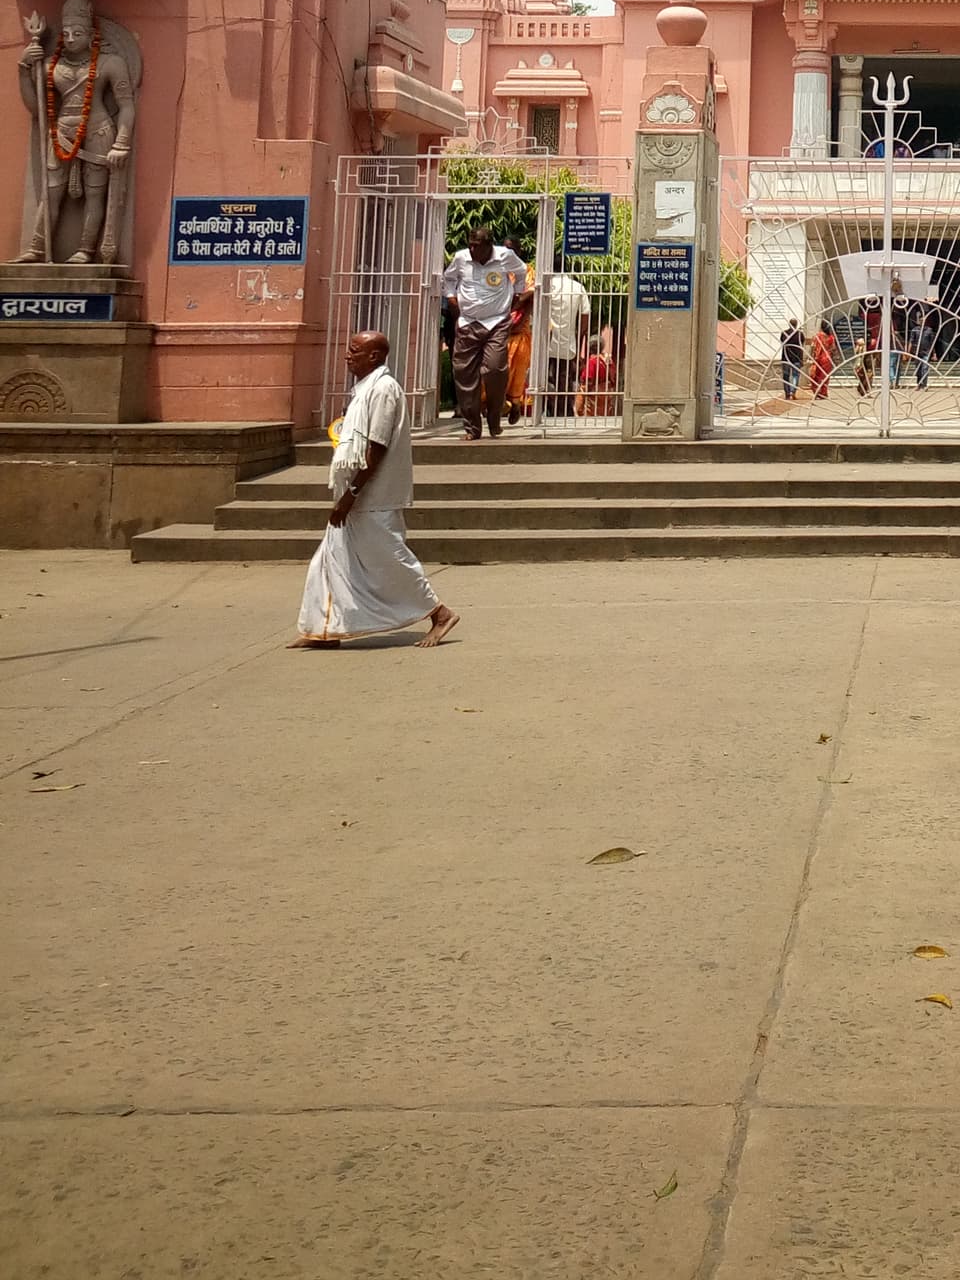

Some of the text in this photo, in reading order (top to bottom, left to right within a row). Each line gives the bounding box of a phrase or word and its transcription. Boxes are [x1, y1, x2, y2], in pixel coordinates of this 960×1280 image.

[664, 186, 686, 195] अन्दर
[220, 204, 257, 214] सूचना
[179, 216, 233, 235] दर्शनार्थियों
[234, 218, 244, 234] से
[247, 217, 284, 238] अनुरोध
[177, 239, 190, 256] कि
[192, 239, 211, 255] पैसा
[253, 239, 262, 255] में
[264, 240, 276, 257] ही
[640, 271, 657, 282] दोपहर
[1, 298, 89, 317] द्वारपाल
